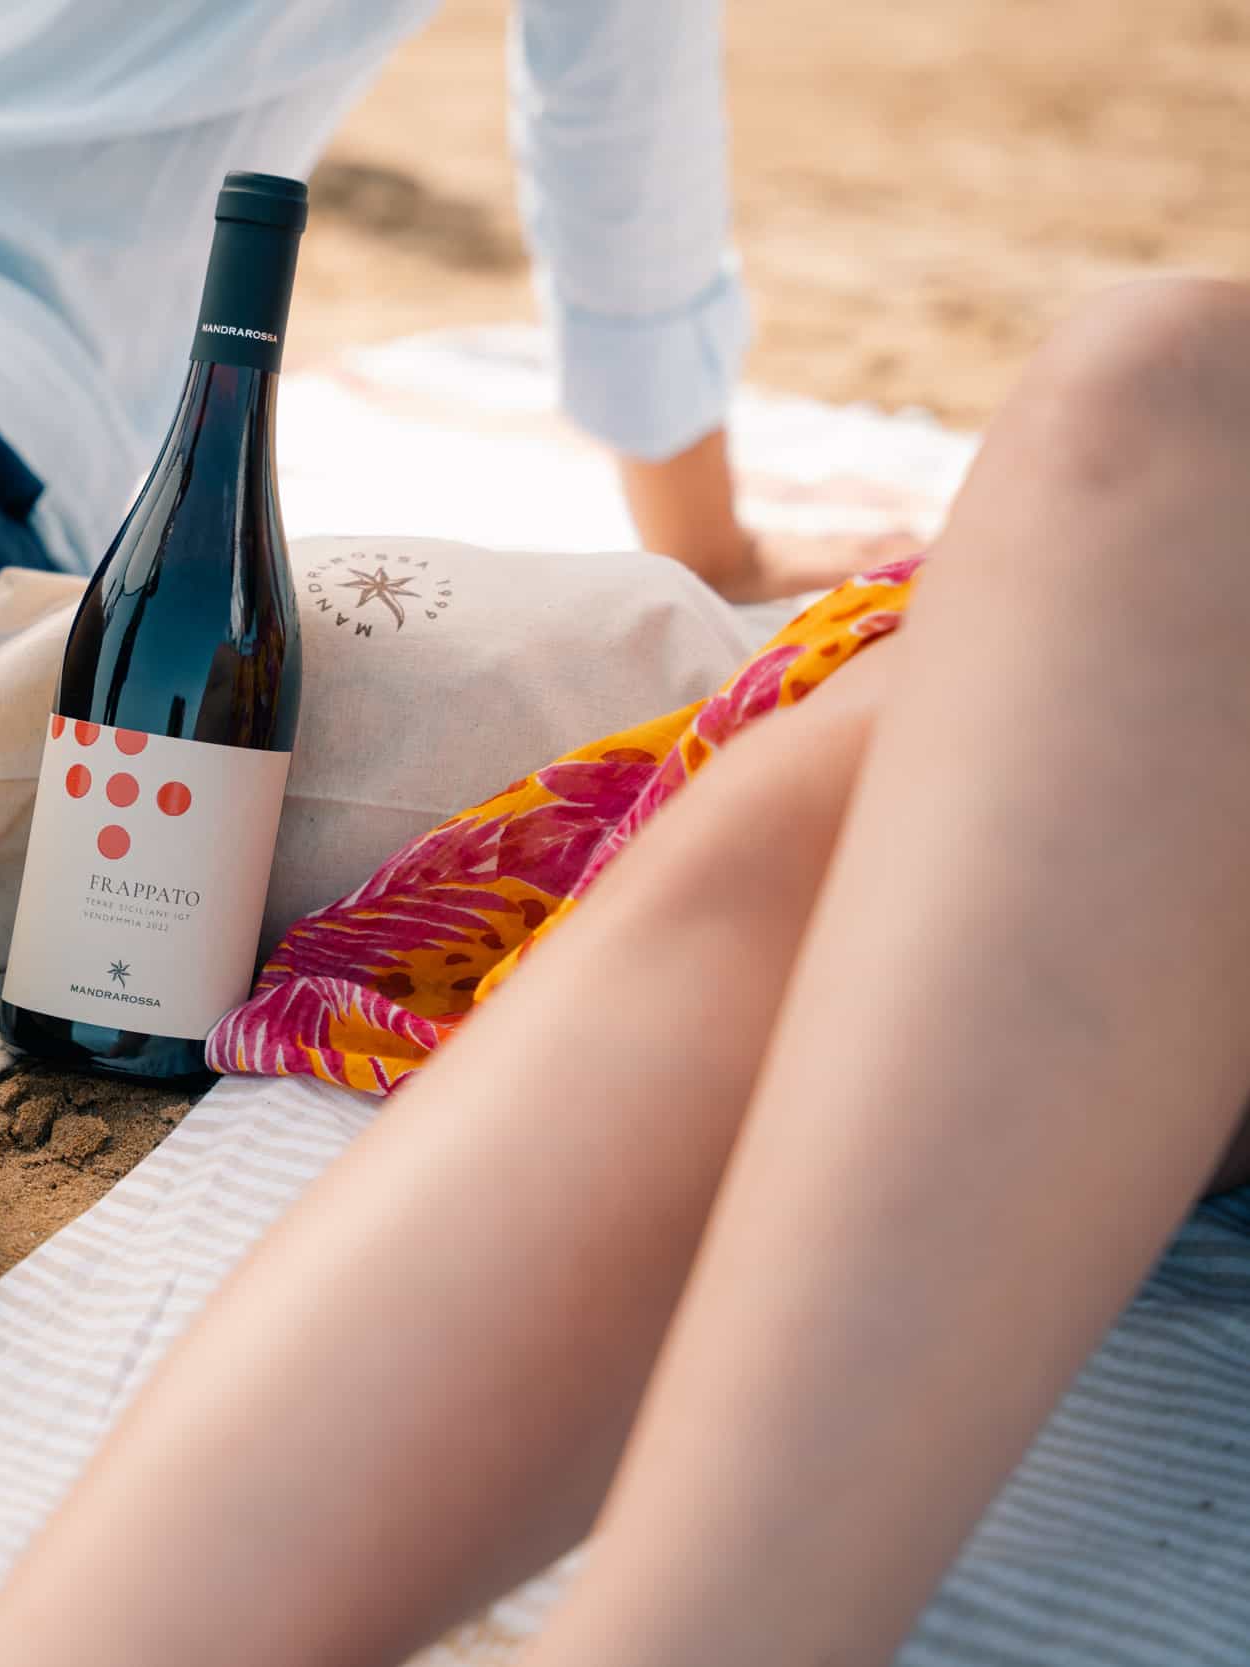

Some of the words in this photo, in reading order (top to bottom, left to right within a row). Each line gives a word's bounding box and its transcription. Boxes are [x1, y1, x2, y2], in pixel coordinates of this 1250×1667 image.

[201, 322, 278, 343] MANDRAROSSA
[90, 874, 200, 907] FRAPPATO
[82, 910, 142, 929] VENDEMMIA
[69, 983, 161, 1008] MANDRAROSSA
